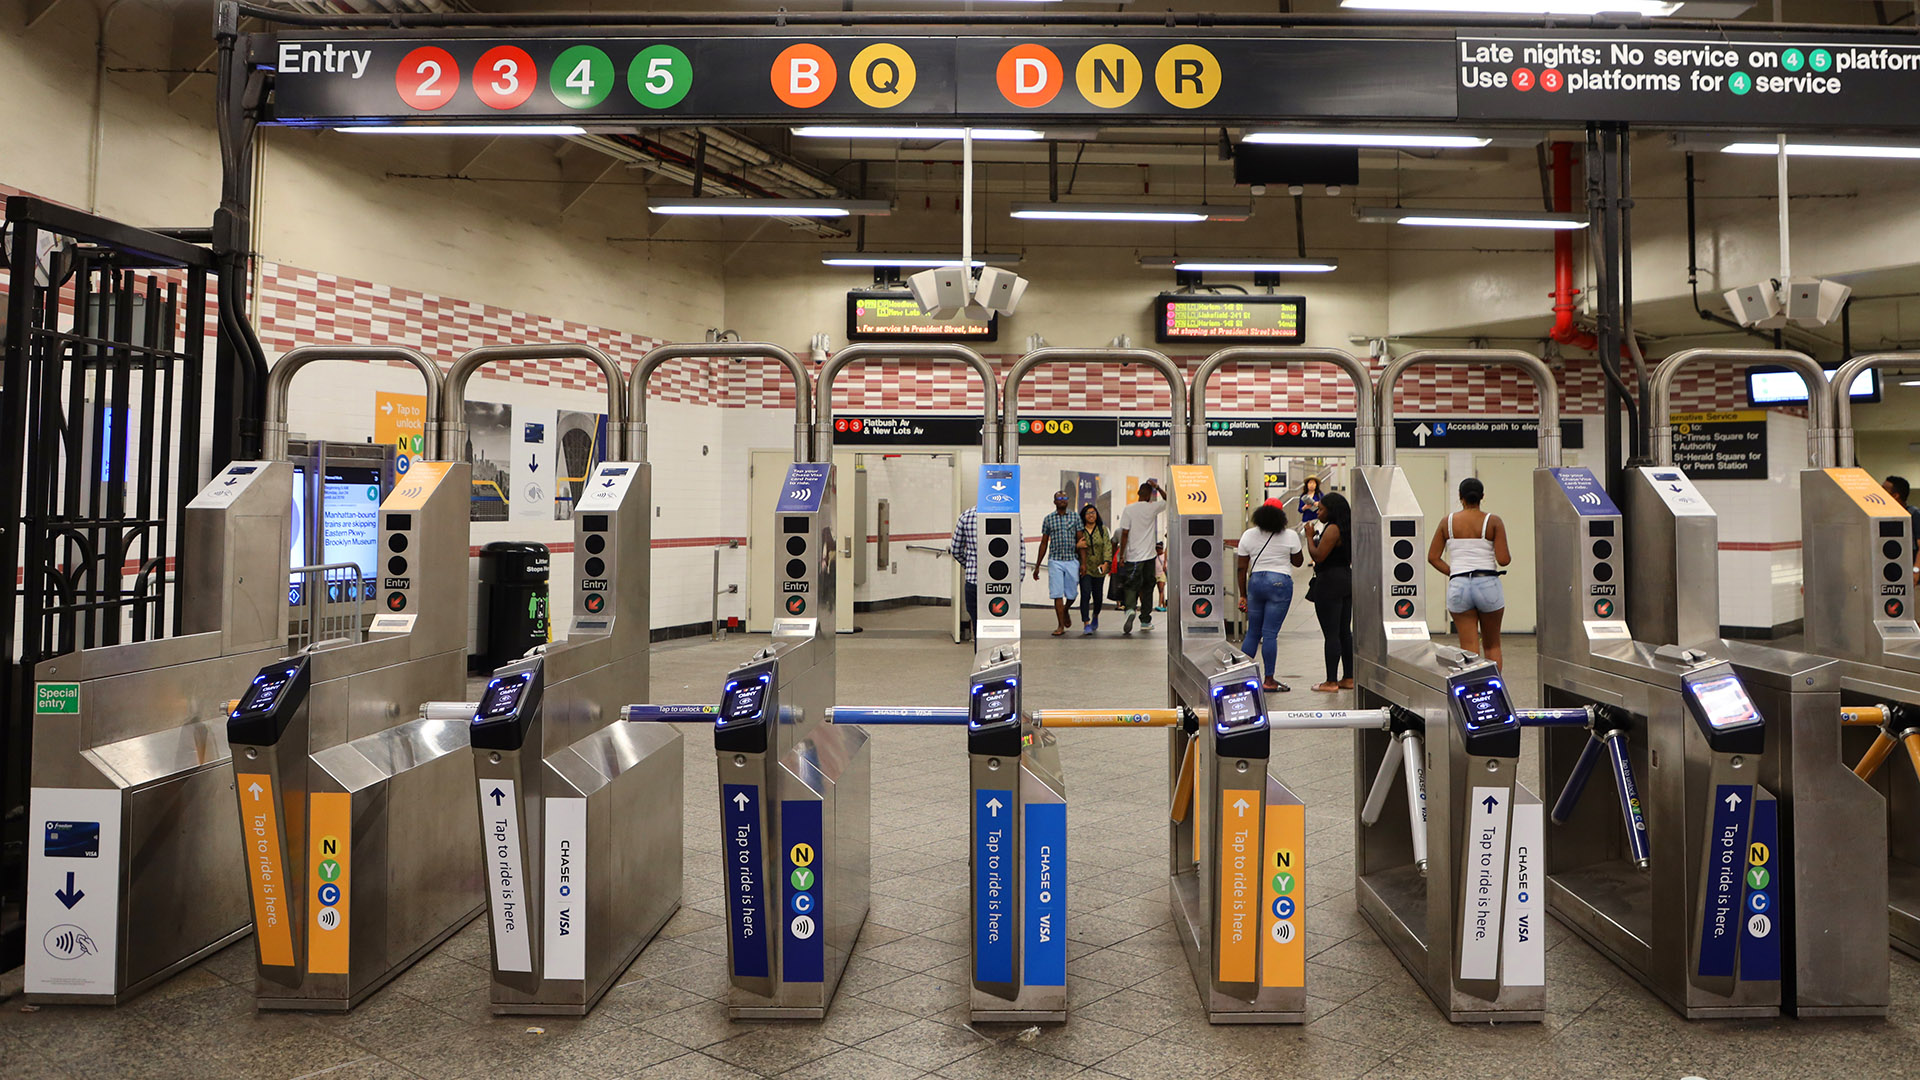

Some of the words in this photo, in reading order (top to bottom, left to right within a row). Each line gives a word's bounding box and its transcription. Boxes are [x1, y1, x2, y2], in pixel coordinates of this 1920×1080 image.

[1461, 42, 1513, 64] Late
[1523, 43, 1601, 69] nights:
[1611, 44, 1644, 66] No
[1654, 46, 1739, 67] service
[1748, 51, 1778, 68] on
[1787, 53, 1799, 67] 4
[1814, 54, 1826, 67] 5
[278, 44, 371, 79] Entry
[416, 60, 441, 96] 2
[491, 59, 519, 95] 3
[565, 59, 594, 94] 4
[645, 58, 674, 94] 5
[790, 58, 820, 94] B
[865, 58, 899, 94] Q
[1015, 58, 1048, 94] D
[1093, 59, 1124, 93] N
[1174, 59, 1205, 94] R
[1462, 67, 1508, 89] Use
[1518, 73, 1529, 87] 2
[1546, 74, 1557, 87] 3
[1568, 69, 1680, 93] platforms
[1690, 69, 1723, 91] for
[1733, 76, 1745, 90] 4
[1756, 73, 1841, 94] service
[863, 324, 874, 333] For
[876, 325, 901, 333] service
[911, 325, 942, 333] President
[1181, 328, 1208, 336] stopping
[396, 404, 410, 417] Tap
[412, 405, 420, 415] to
[1706, 412, 1738, 420] Service
[396, 418, 422, 429] unlock
[839, 422, 845, 430] 2
[853, 422, 859, 430] 3
[863, 419, 898, 427] Flatbush
[901, 419, 910, 427] Av
[1138, 421, 1160, 429] nights:
[1230, 421, 1260, 430] platform.
[1278, 424, 1284, 433] 2
[1292, 424, 1298, 433] 3
[1301, 422, 1342, 430] Manhattan
[1447, 422, 1489, 431] Accessible
[1491, 423, 1509, 432] path
[863, 427, 870, 435] &
[873, 427, 891, 435] New
[893, 427, 912, 435] Lots
[914, 427, 923, 435] Av
[1301, 430, 1308, 438] &
[1311, 430, 1325, 438] The
[1327, 430, 1350, 438] Bronx
[1673, 433, 1711, 441] St-Times
[1714, 432, 1744, 442] Square
[1747, 432, 1759, 440] for
[399, 437, 407, 449] N
[413, 438, 421, 450] Y
[1679, 442, 1717, 451] Authority
[1674, 453, 1713, 461] St-Herald
[1716, 452, 1746, 461] Square
[1749, 452, 1761, 460] for
[399, 458, 407, 470] C
[1694, 462, 1715, 470] Penn
[1717, 462, 1748, 470] Station
[370, 488, 375, 498] 4
[325, 511, 376, 519] Manhattan-bound
[352, 520, 376, 529] skipping
[348, 530, 366, 538] Pkwy-
[325, 538, 352, 547] Brooklyn
[352, 538, 377, 546] Museum
[386, 579, 410, 589] Entry
[583, 580, 607, 590] Entry
[784, 582, 808, 592] Entry
[986, 583, 1011, 594] Entry
[1190, 584, 1215, 595] Entry
[1591, 585, 1615, 595] Entry
[1881, 585, 1904, 595] Entry
[1392, 585, 1416, 596] Entry
[39, 687, 77, 698] Special
[39, 698, 66, 710] entry
[1228, 696, 1247, 704] OMNY
[1472, 695, 1491, 703] OMNY
[254, 814, 266, 836] Tap
[494, 818, 507, 841] Tap
[736, 824, 750, 846] Tap
[986, 829, 1001, 852] Tap
[1232, 830, 1248, 852] Tap
[1480, 826, 1495, 849] Tap
[1721, 824, 1738, 846] Tap
[258, 839, 267, 852] to
[498, 844, 508, 858] to
[560, 840, 570, 883] CHASE
[739, 849, 750, 863] to
[989, 855, 1000, 869] to
[1235, 855, 1246, 869] to
[1481, 852, 1492, 866] to
[1722, 849, 1733, 863] to
[260, 857, 273, 880] ride
[500, 861, 512, 886] ride
[1040, 846, 1051, 890] CHASE
[1518, 847, 1528, 889] CHASE
[741, 866, 753, 891] ride
[989, 872, 1002, 897] ride
[1234, 872, 1247, 897] ride
[1479, 869, 1492, 894] ride
[1719, 866, 1733, 891] ride
[264, 884, 272, 893] is
[503, 889, 511, 899] is
[742, 895, 753, 904] is
[990, 900, 1001, 909] is
[1234, 900, 1243, 909] is
[1478, 897, 1490, 907] is
[1718, 894, 1730, 904] is
[266, 896, 276, 927] here.
[504, 902, 515, 933] here.
[559, 908, 570, 936] VISA
[743, 907, 755, 938] here.
[1233, 913, 1246, 943] here.
[1476, 910, 1490, 941] here.
[1714, 907, 1729, 938] here.
[989, 913, 1001, 944] here.
[1039, 915, 1050, 943] VISA
[1518, 914, 1528, 943] VISA
